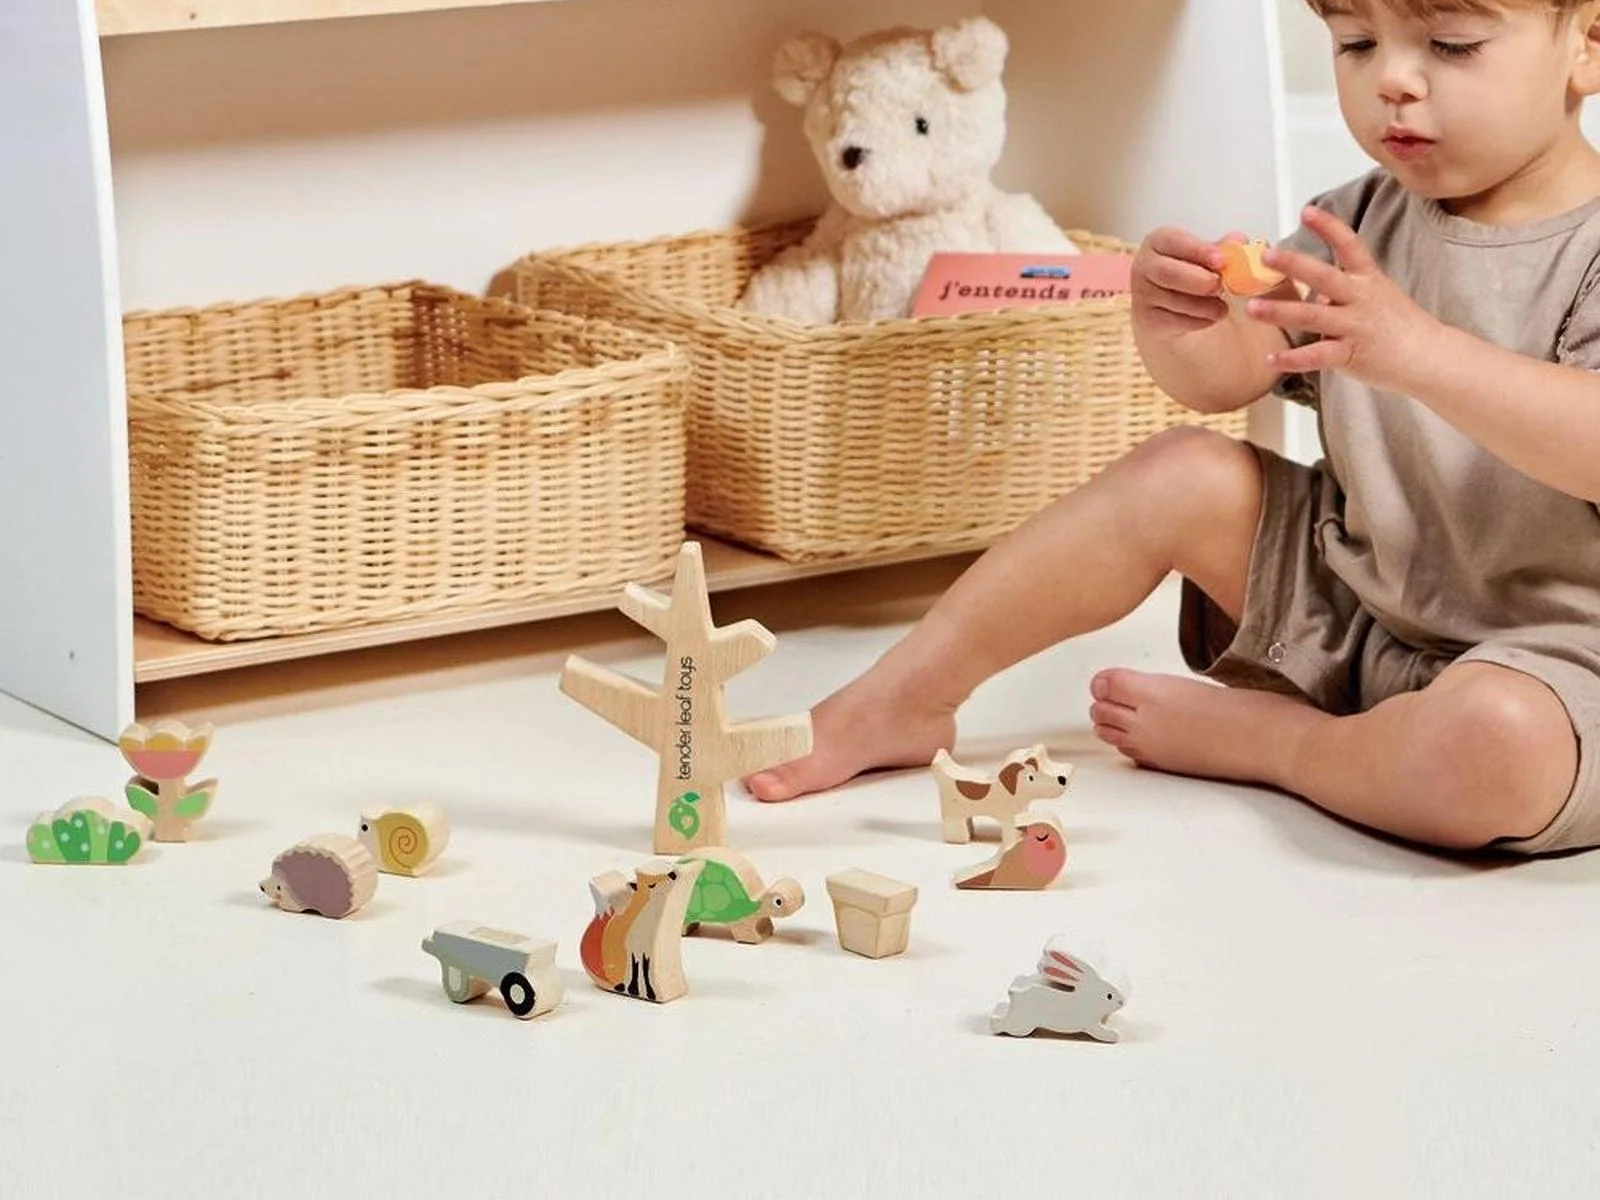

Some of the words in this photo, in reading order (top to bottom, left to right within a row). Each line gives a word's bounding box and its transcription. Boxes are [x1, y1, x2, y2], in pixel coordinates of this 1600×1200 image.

[939, 281, 1072, 301] j'entends
[678, 655, 697, 691] toys
[675, 695, 692, 725] leaf
[675, 727, 692, 780] tender
